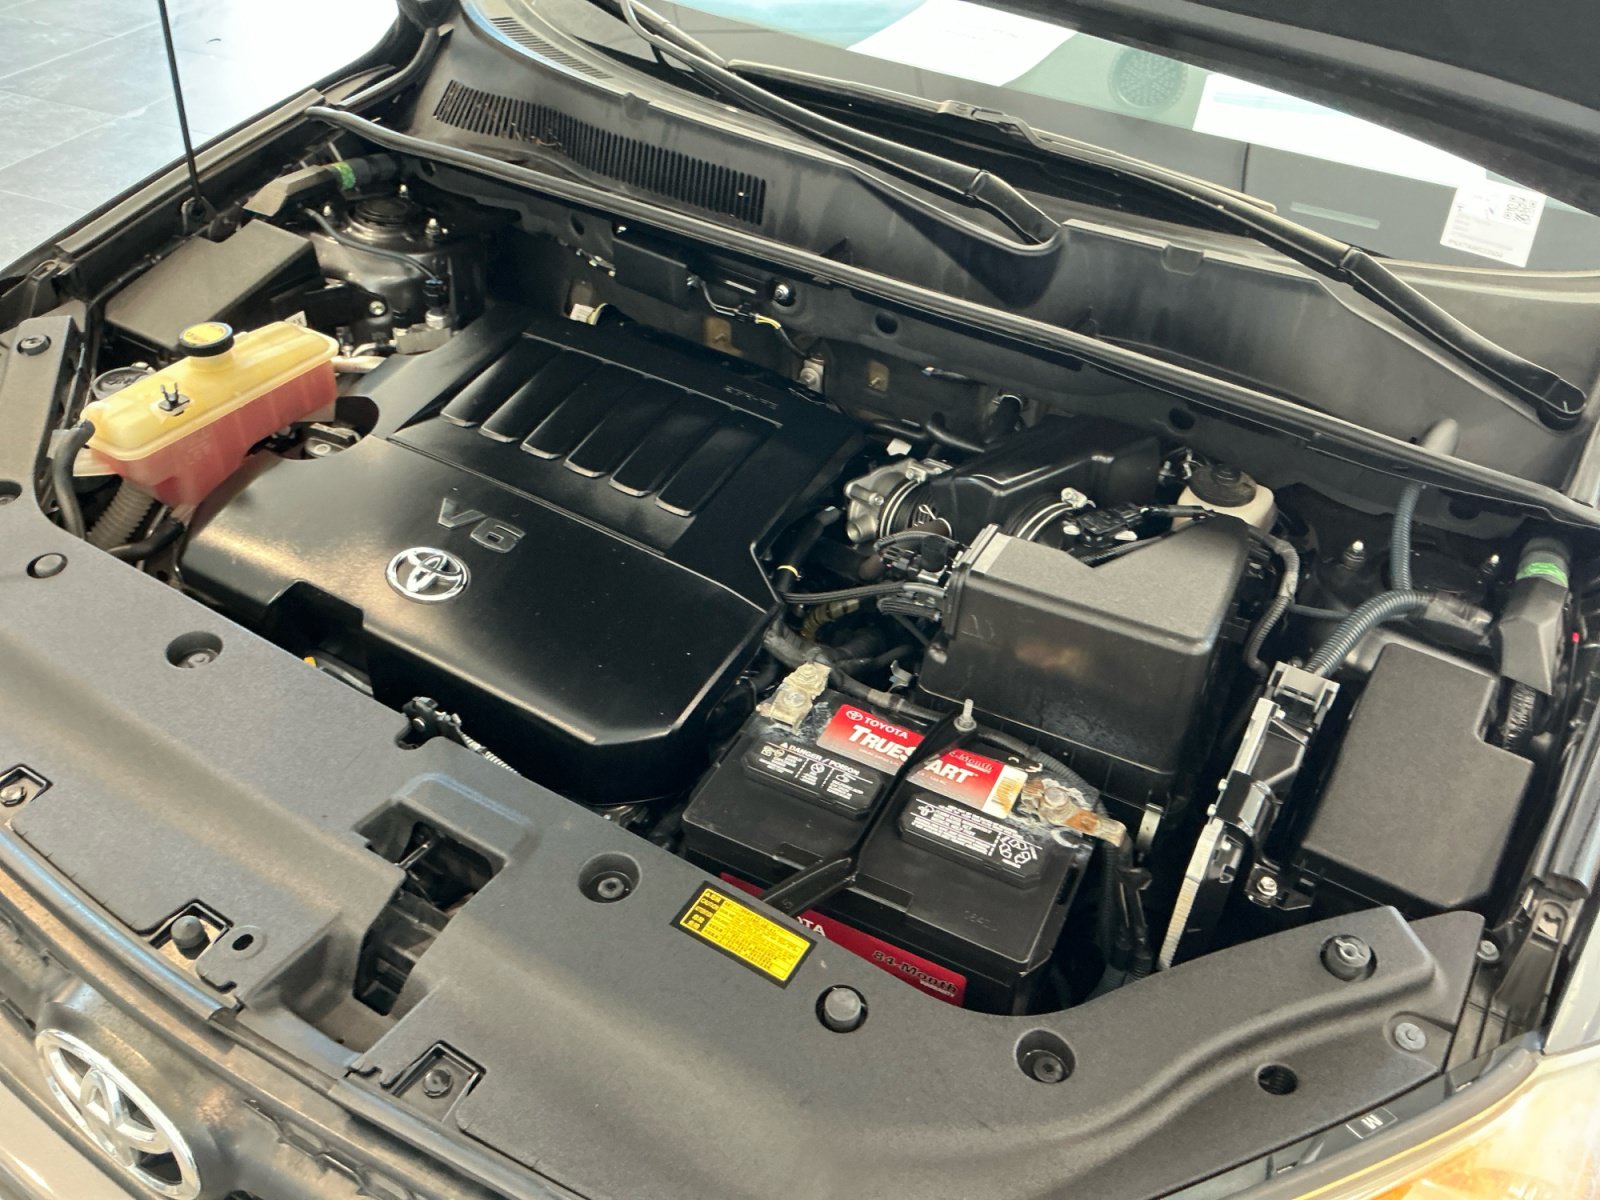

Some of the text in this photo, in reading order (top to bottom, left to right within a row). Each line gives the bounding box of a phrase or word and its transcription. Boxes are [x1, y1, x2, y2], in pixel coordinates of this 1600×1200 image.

[437, 497, 526, 554] V6
[864, 717, 909, 739] TOYOTA
[788, 744, 823, 762] DANGER
[829, 759, 861, 775] POISON
